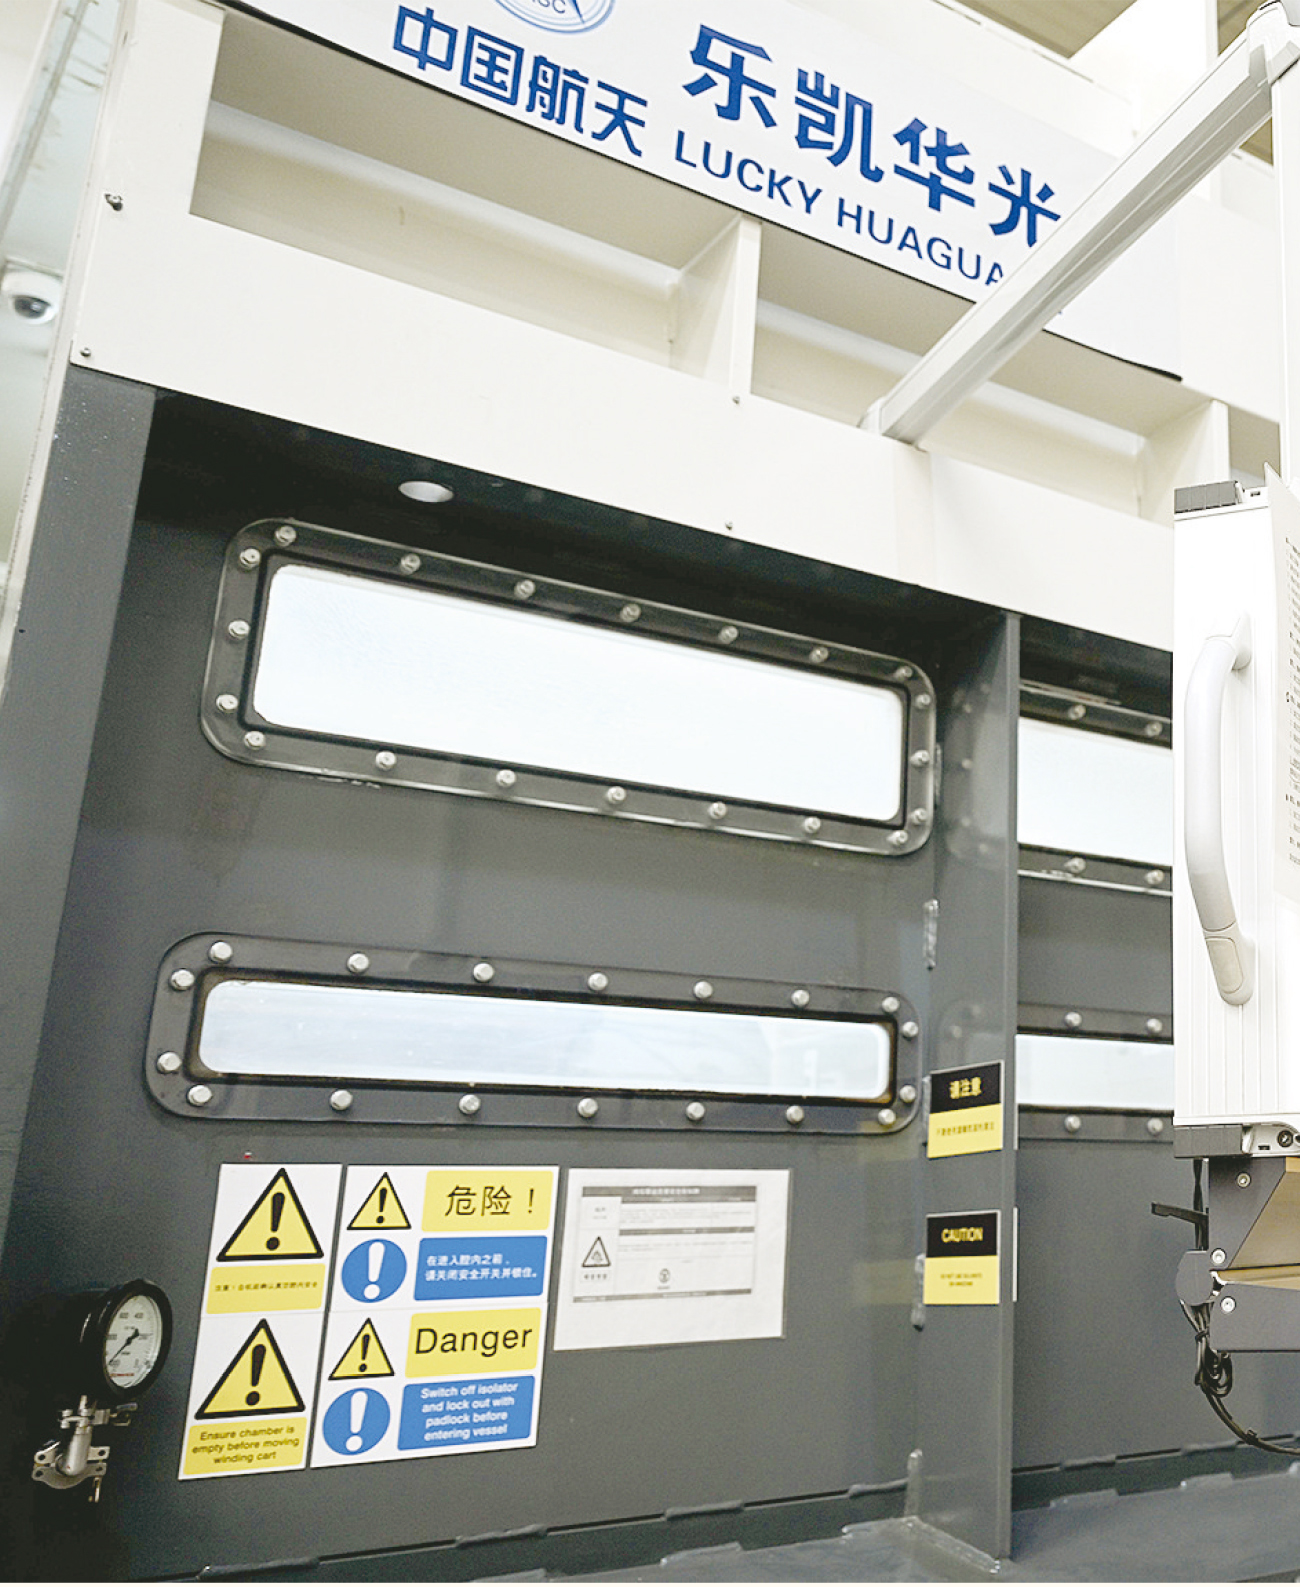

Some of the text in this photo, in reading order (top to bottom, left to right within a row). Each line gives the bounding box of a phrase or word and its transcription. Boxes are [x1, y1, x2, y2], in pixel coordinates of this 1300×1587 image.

[393, 5, 648, 157] 中国航天
[682, 24, 1061, 248] 乐凯华光
[675, 130, 822, 215] LUCKY
[445, 1185, 535, 1217] 危险！
[941, 1227, 984, 1243] CAUTION
[414, 1327, 533, 1358] Danger
[421, 1382, 519, 1399] Switch off isolator
[422, 1396, 515, 1413] and lock out with
[425, 1411, 508, 1429] padlock before
[200, 1425, 295, 1441] Ensure chamber is
[424, 1423, 508, 1441] entering vessel
[192, 1437, 300, 1455] empty before moving
[213, 1451, 277, 1464] winding cart
